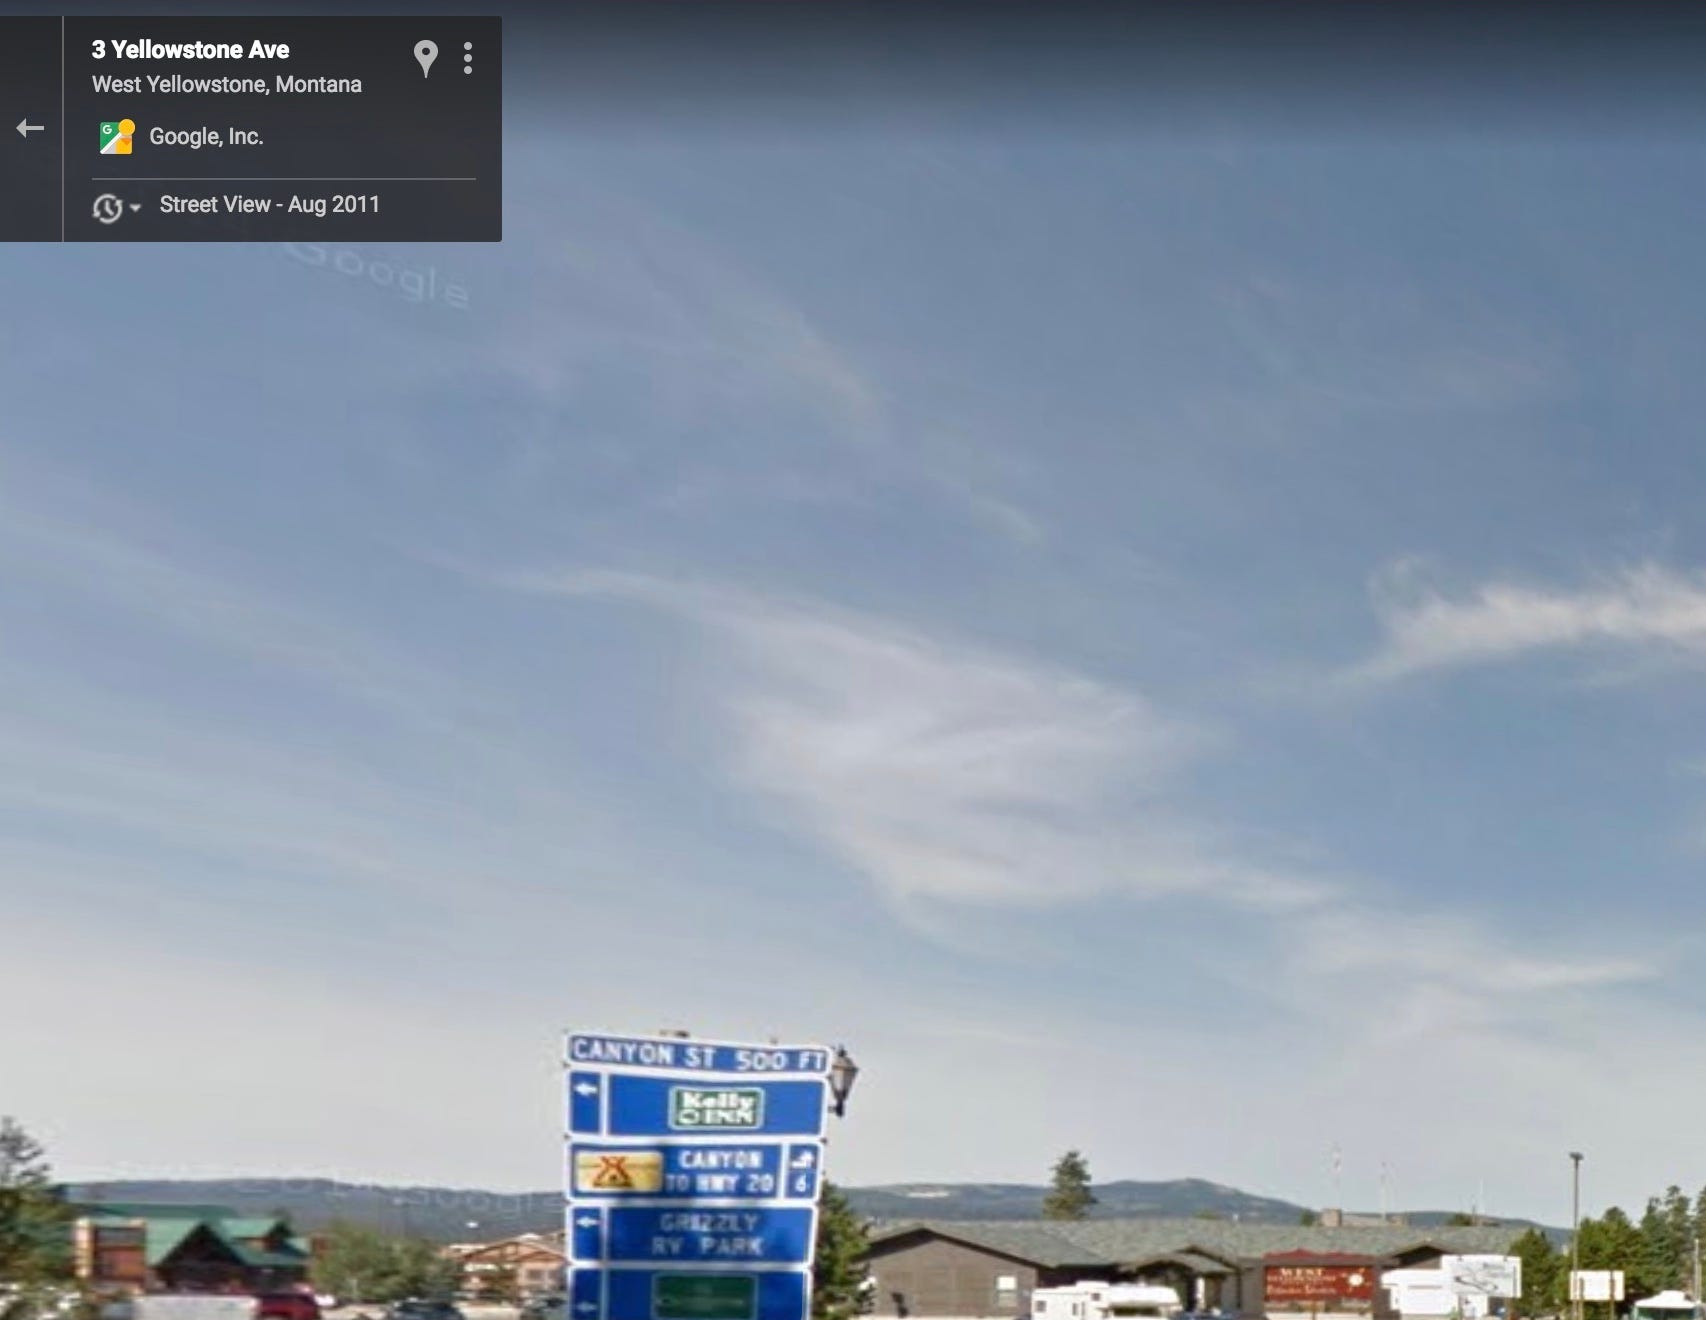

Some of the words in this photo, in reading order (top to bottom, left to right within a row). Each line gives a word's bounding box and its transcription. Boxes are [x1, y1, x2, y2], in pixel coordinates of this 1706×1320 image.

[573, 1040, 674, 1066] CANYON
[684, 1046, 716, 1068] ST
[735, 1051, 787, 1072] 500
[798, 1052, 826, 1071] FT
[681, 1090, 756, 1113] Kelly
[678, 1150, 764, 1170] CANYON
[665, 1174, 691, 1192] TO
[695, 1173, 741, 1193] HWY
[746, 1173, 775, 1194] 20
[660, 1213, 759, 1233] GRIZZLY
[651, 1236, 684, 1256] RV
[701, 1236, 765, 1256] PARK
